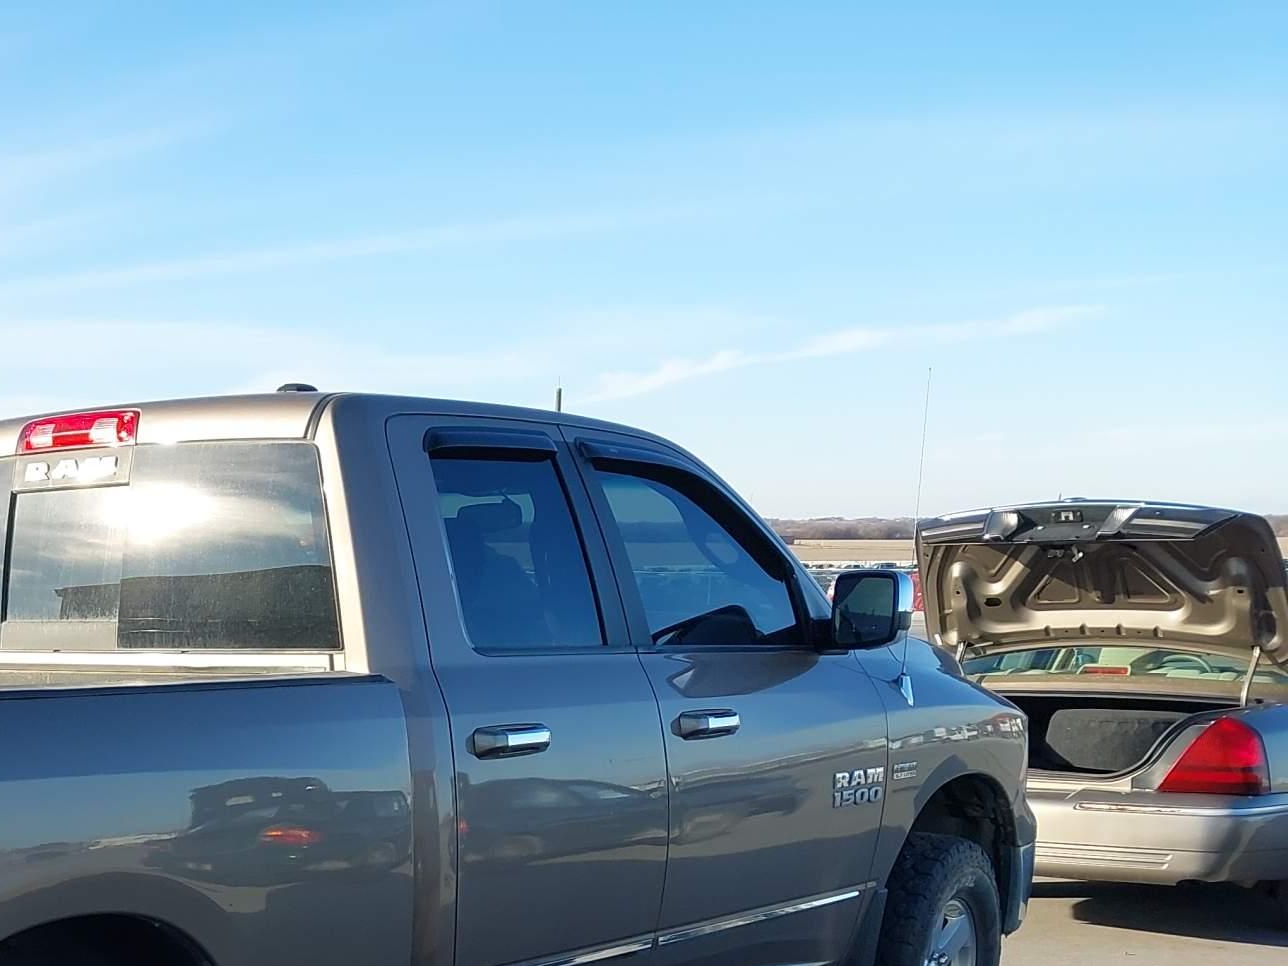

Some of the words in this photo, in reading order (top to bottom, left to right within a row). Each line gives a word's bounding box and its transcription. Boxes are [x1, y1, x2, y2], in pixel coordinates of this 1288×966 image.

[25, 456, 118, 481] RAM
[833, 767, 884, 788] RAM
[833, 786, 882, 808] 1500
